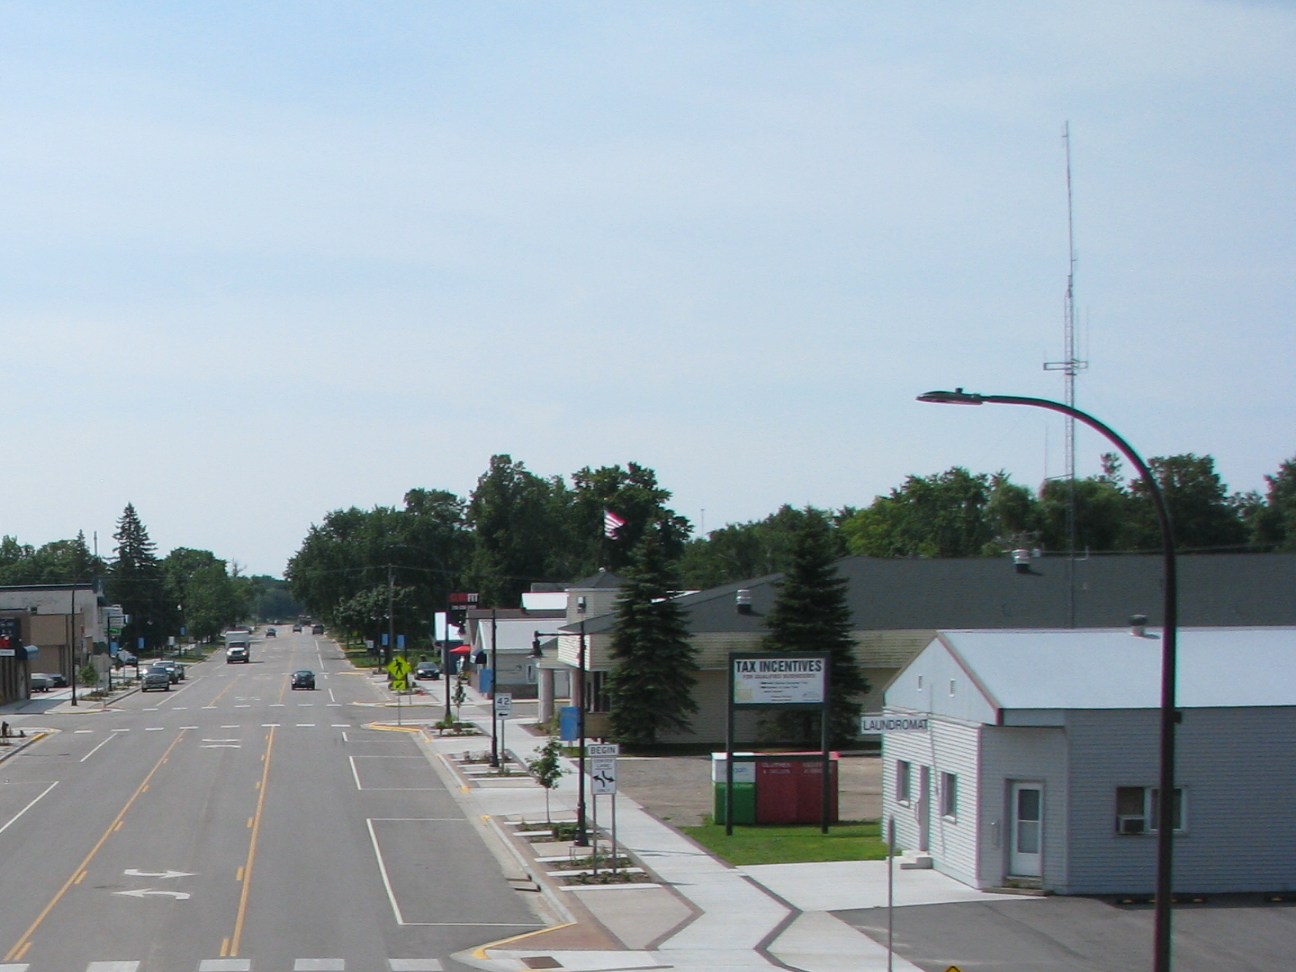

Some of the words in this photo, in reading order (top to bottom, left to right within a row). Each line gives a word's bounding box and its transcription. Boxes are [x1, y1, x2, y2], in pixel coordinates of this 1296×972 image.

[735, 660, 756, 673] TAX
[759, 660, 822, 673] INCENTIVES
[496, 697, 510, 706] 42
[864, 719, 928, 731] LAUNDROMAT
[590, 746, 616, 755] BEGIN
